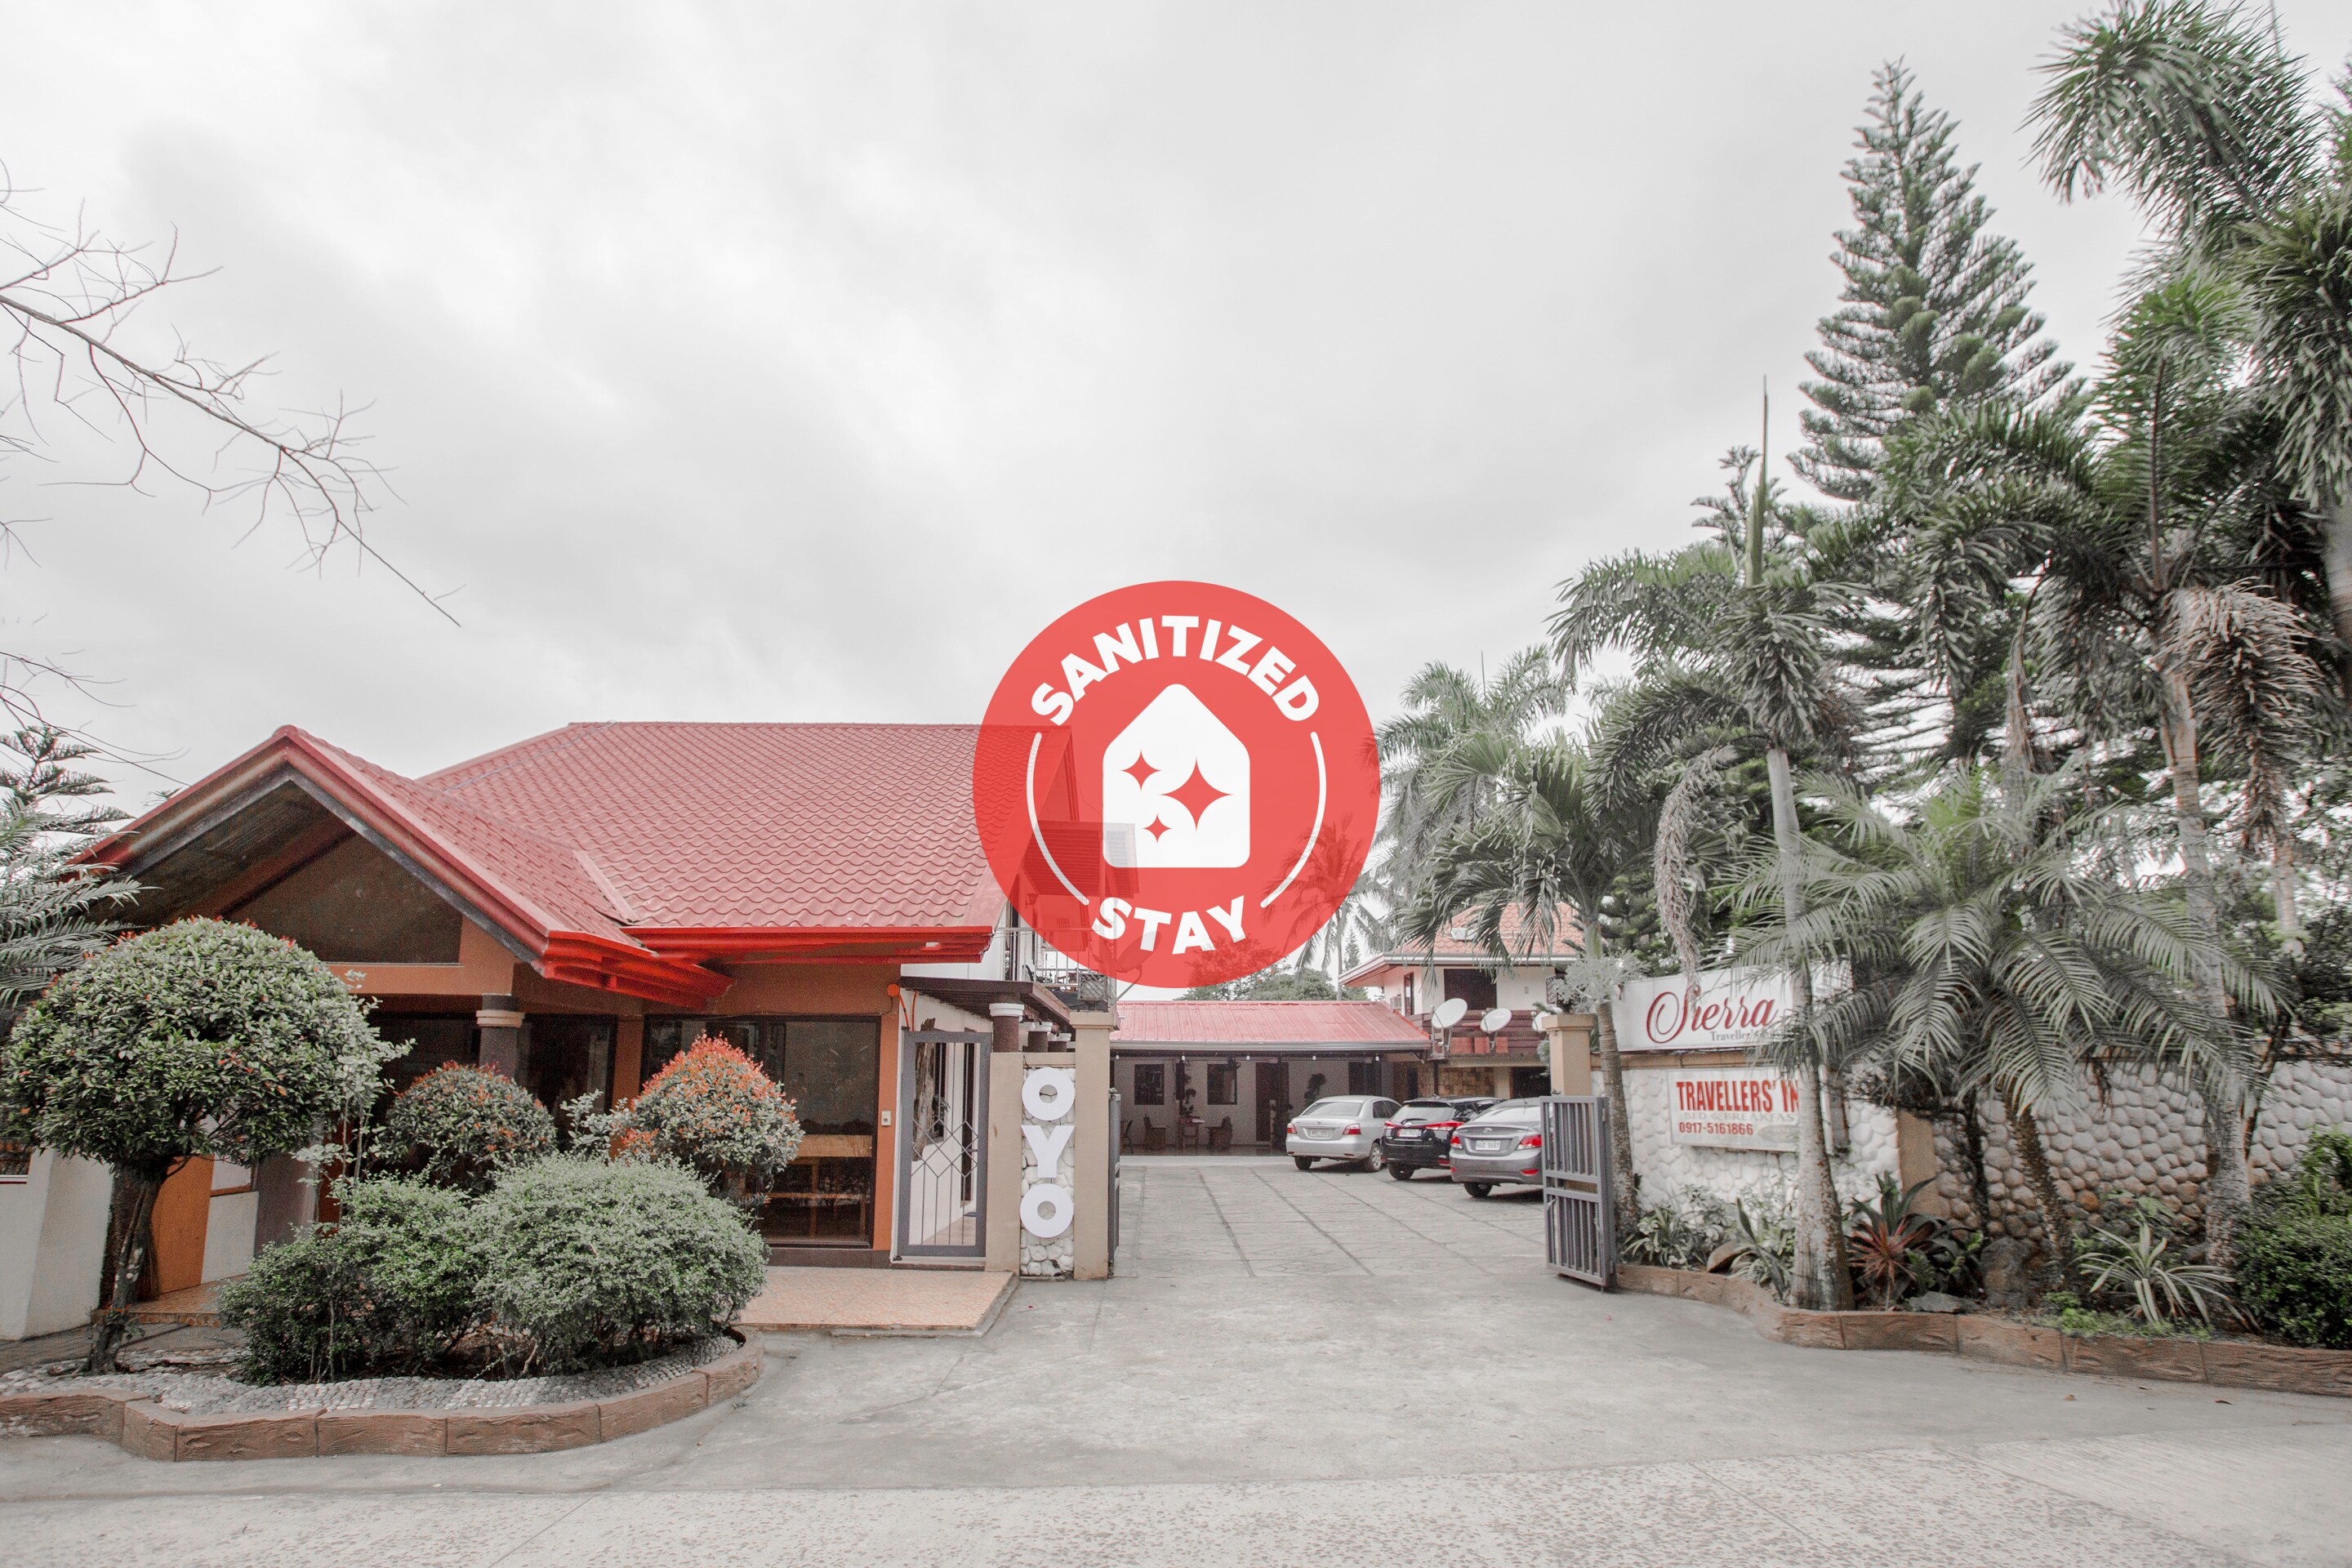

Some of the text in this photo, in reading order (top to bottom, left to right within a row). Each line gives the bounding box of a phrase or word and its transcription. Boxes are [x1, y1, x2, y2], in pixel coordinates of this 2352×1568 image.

[1646, 983, 1778, 1044] Sierra
[1676, 1079, 1799, 1113] TRAVELLERS' IN
[1679, 1121, 1754, 1136] 0917-5161866
[1684, 1111, 1707, 1120] BED
[1724, 1111, 1795, 1123] BREAKFAS
[1019, 1067, 1076, 1238] OYO
